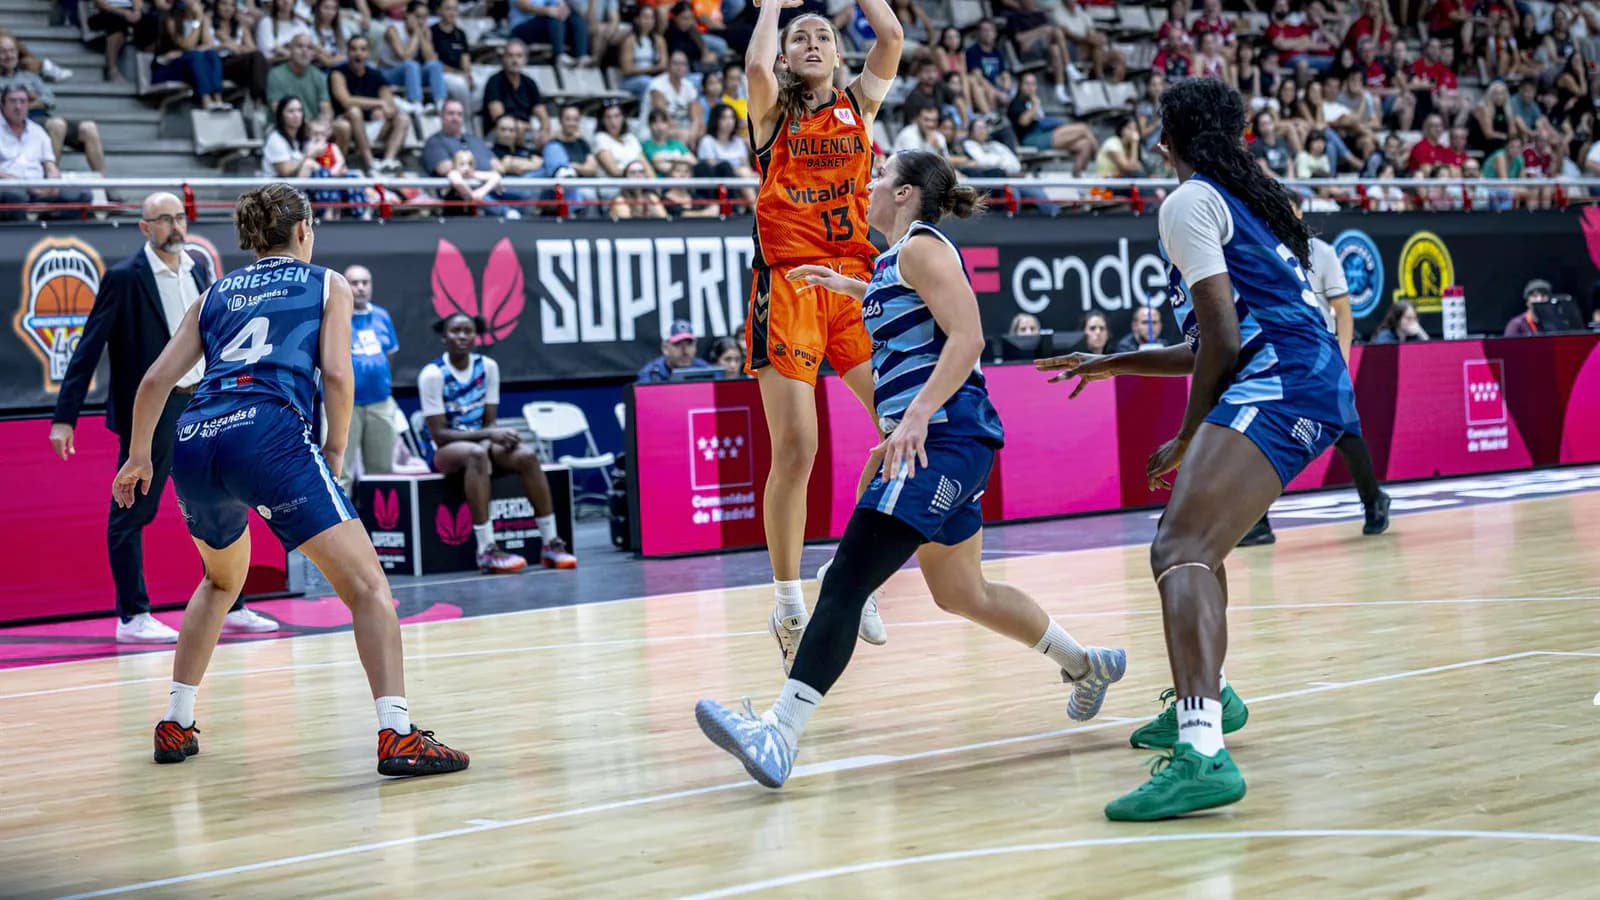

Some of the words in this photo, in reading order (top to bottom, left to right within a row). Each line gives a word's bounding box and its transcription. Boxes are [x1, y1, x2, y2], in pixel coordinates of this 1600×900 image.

[787, 136, 865, 156] VALENCIA
[807, 157, 846, 168] BASKET
[786, 177, 855, 203] Vitaldi
[821, 206, 854, 241] 13
[218, 266, 310, 292] DRIESSEN
[220, 316, 273, 365] 4
[202, 410, 247, 430] Leganés
[692, 491, 754, 508] Comunidad
[693, 511, 710, 524] de
[712, 505, 755, 522] Madrid
[1180, 718, 1212, 730] adidas
